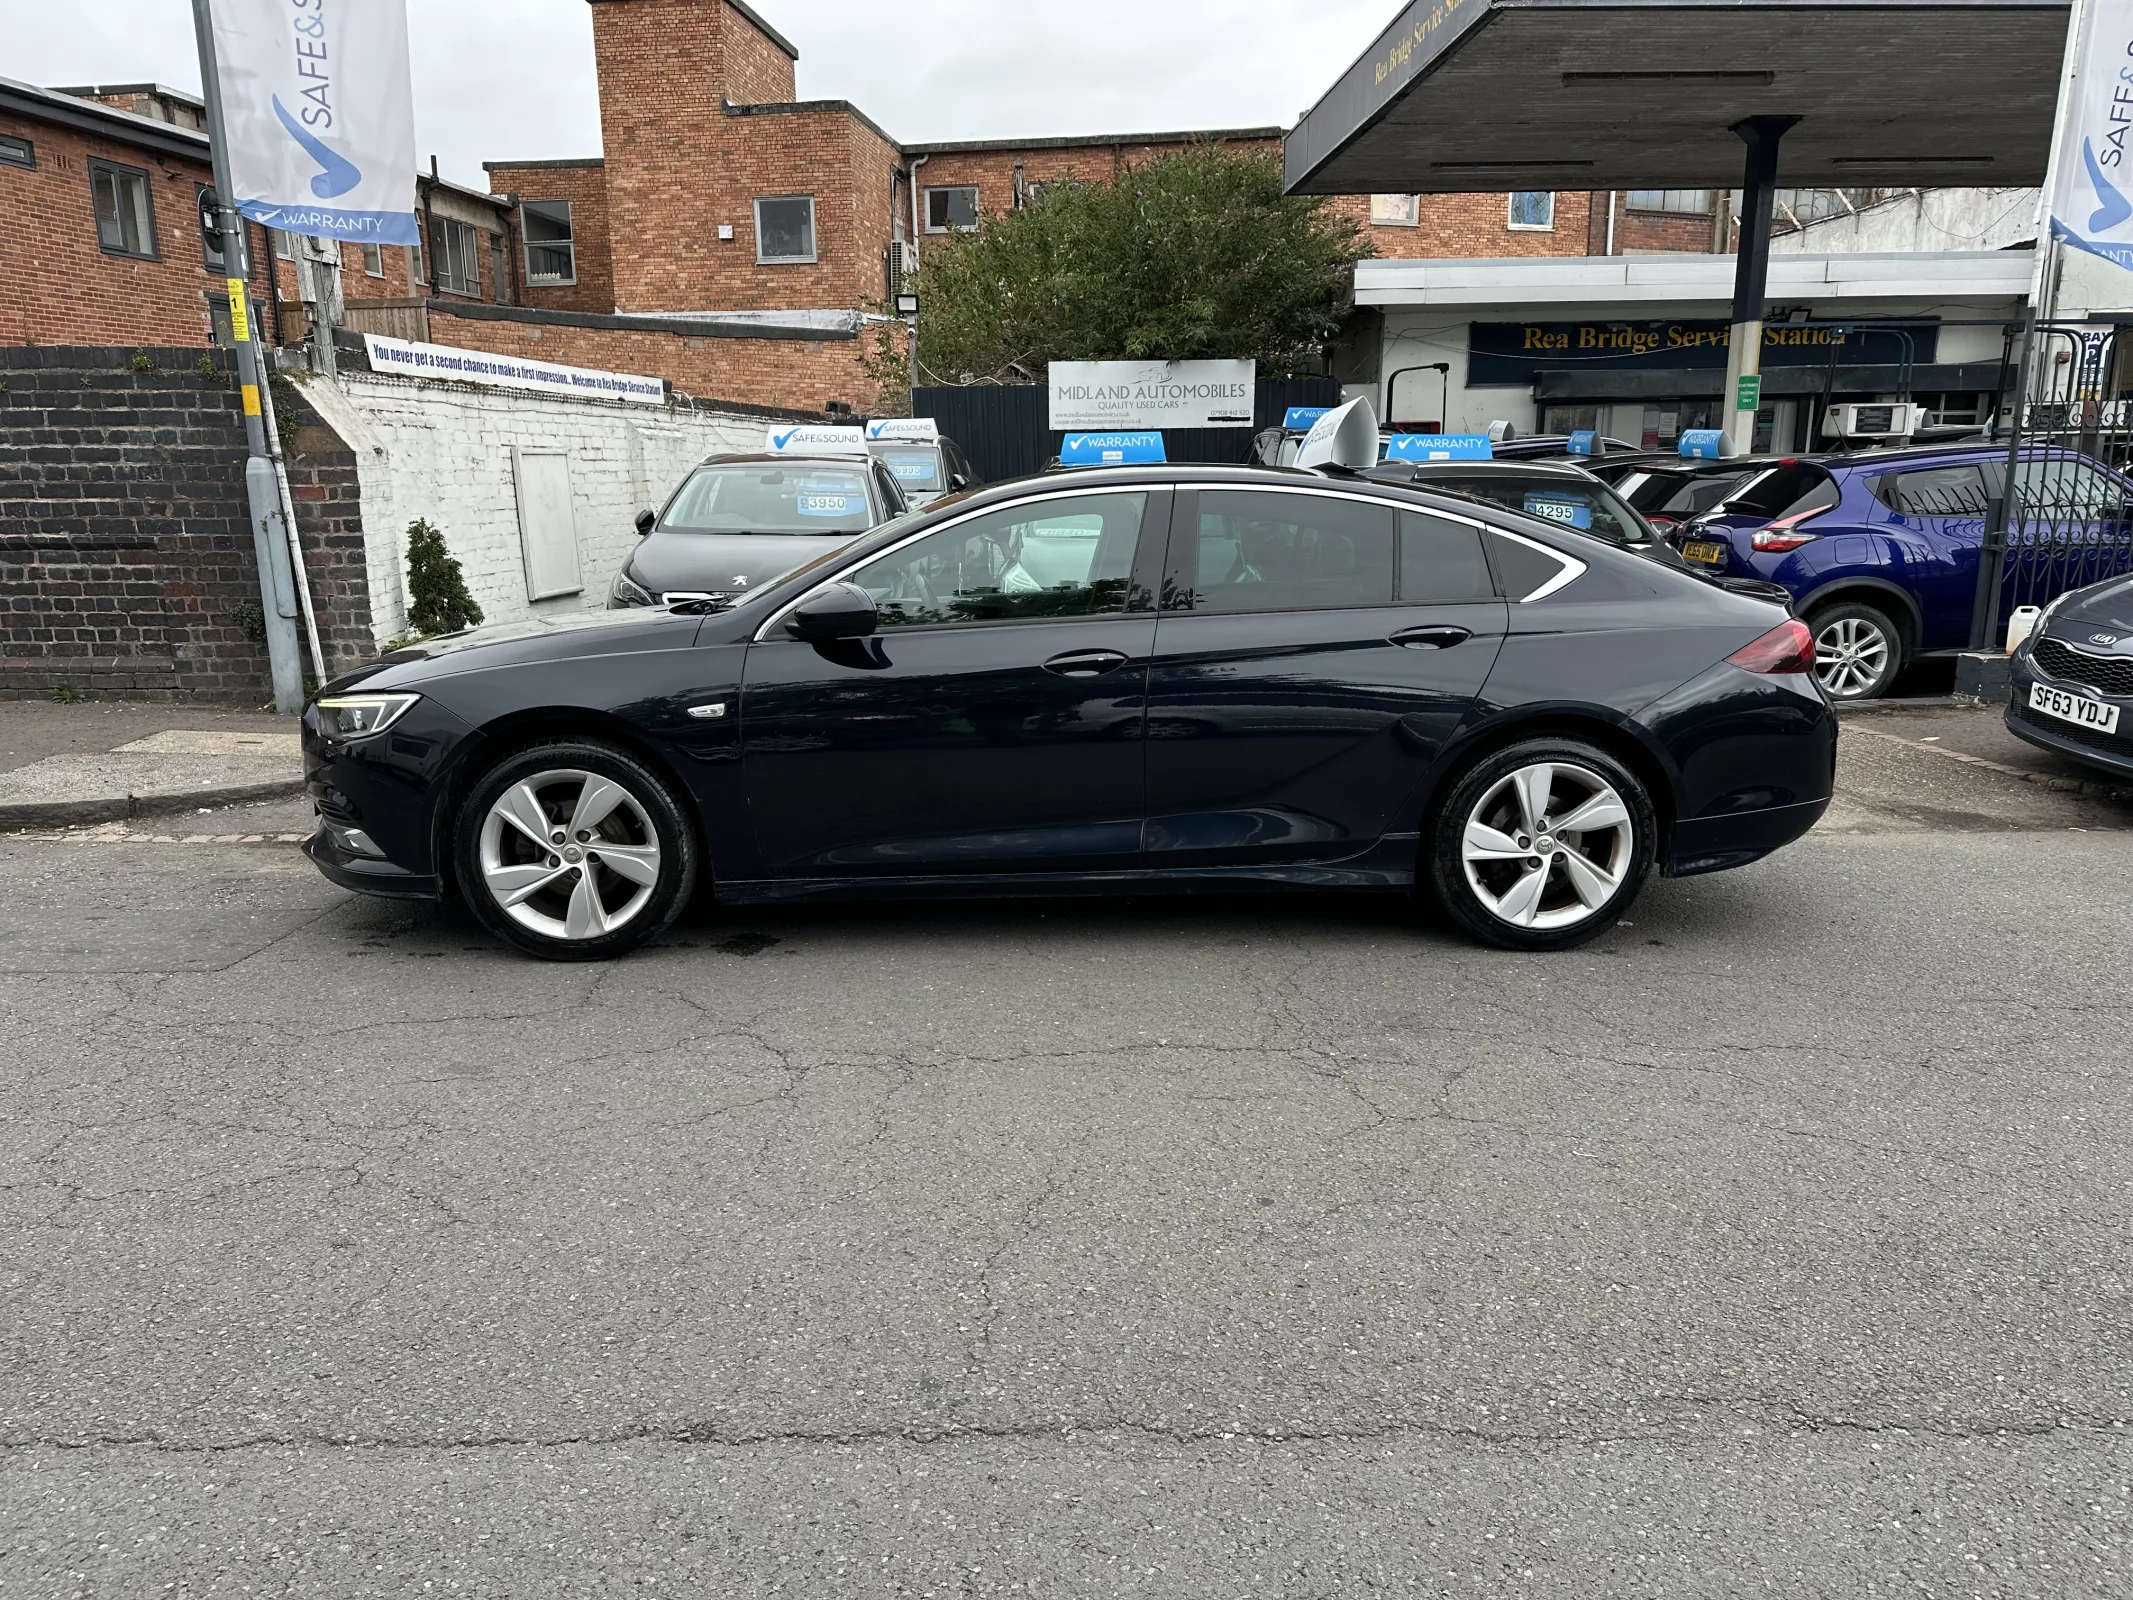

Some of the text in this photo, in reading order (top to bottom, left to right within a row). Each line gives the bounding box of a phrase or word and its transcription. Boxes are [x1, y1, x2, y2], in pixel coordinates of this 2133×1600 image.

[1375, 0, 1462, 85] Rea Bridge Service Sta
[2100, 41, 2133, 168] SAFE&
[281, 212, 384, 232] WARRANTY
[231, 298, 237, 308] 1
[1522, 328, 1568, 348] Rea
[1578, 326, 1660, 354] Bridge
[1667, 326, 1730, 347] Servi
[2086, 344, 2101, 365] 2
[374, 344, 390, 360] You
[390, 349, 413, 364] never
[415, 352, 428, 366] get
[430, 355, 435, 366] a
[436, 356, 462, 370] second
[464, 358, 489, 374] chance
[490, 362, 496, 375] to
[498, 364, 516, 376] make
[516, 366, 521, 378] a
[522, 366, 535, 380] first
[571, 374, 596, 388] Welcome
[596, 378, 602, 388] to
[602, 378, 612, 390] Rea
[612, 379, 628, 393] Bridge
[628, 380, 645, 394] Service
[645, 382, 660, 396] Station
[1058, 384, 1246, 400] MIDLAND AUTOMOBILES
[1098, 402, 1134, 410] QUALITY
[1158, 400, 1179, 408] CARS
[884, 424, 932, 432] SAFE&SOUND
[792, 434, 858, 444] SAFE&SOUND
[1088, 436, 1156, 448] WARRANTY
[1414, 438, 1484, 449] WARRANTY
[1688, 434, 1718, 444] WARRANTY
[2092, 634, 2113, 643] KIA
[2035, 686, 2112, 726] SF63 YDJ
